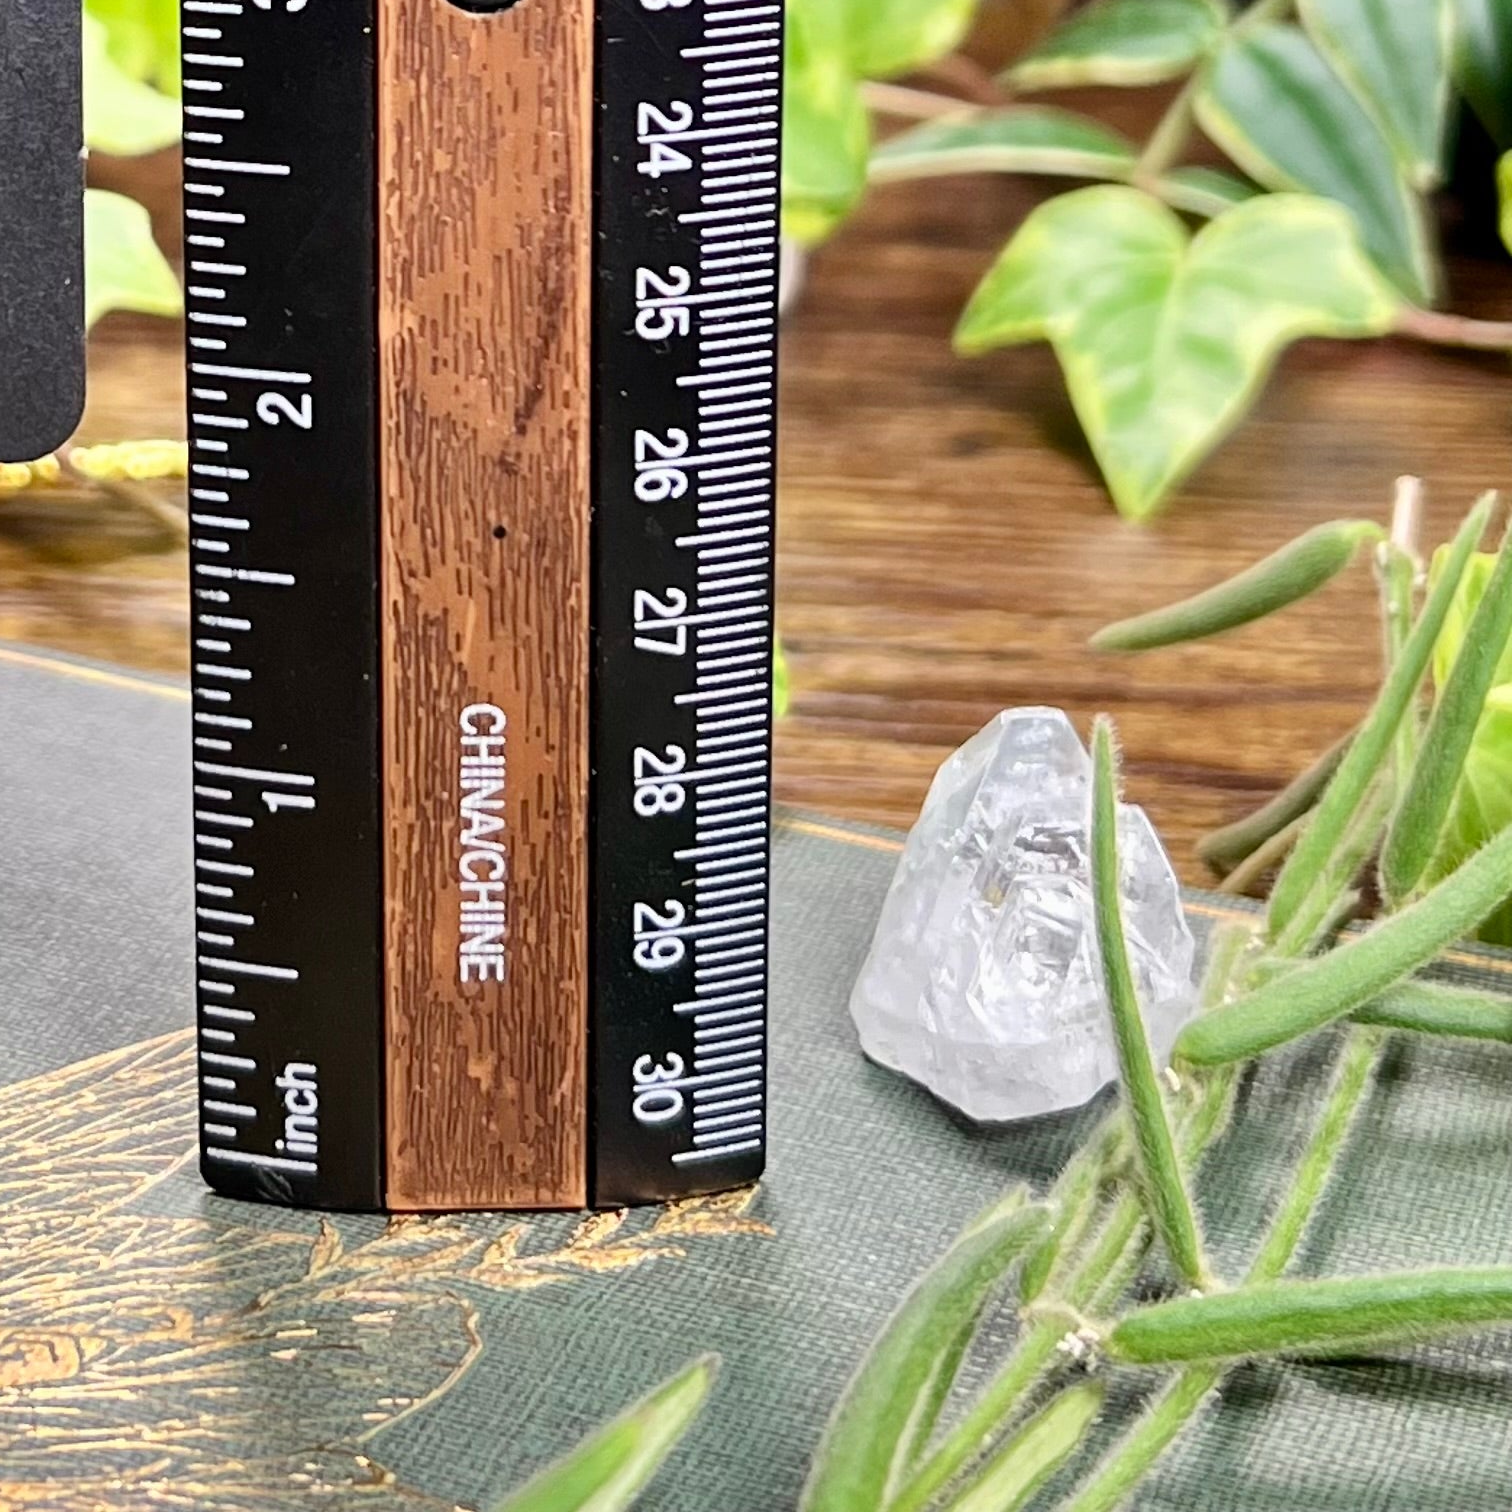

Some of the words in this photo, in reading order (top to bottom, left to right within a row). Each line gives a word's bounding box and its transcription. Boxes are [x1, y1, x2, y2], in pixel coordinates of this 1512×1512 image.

[637, 101, 693, 178] 24
[635, 266, 691, 341] 25
[256, 393, 312, 429] 2
[634, 428, 688, 503] 26
[633, 587, 687, 656] 27
[262, 791, 316, 814] 1
[633, 744, 686, 818] 28
[459, 702, 506, 983] CHINA/CHINE
[633, 898, 686, 973] 29
[275, 1063, 318, 1154] inch
[632, 1051, 685, 1124] 30
